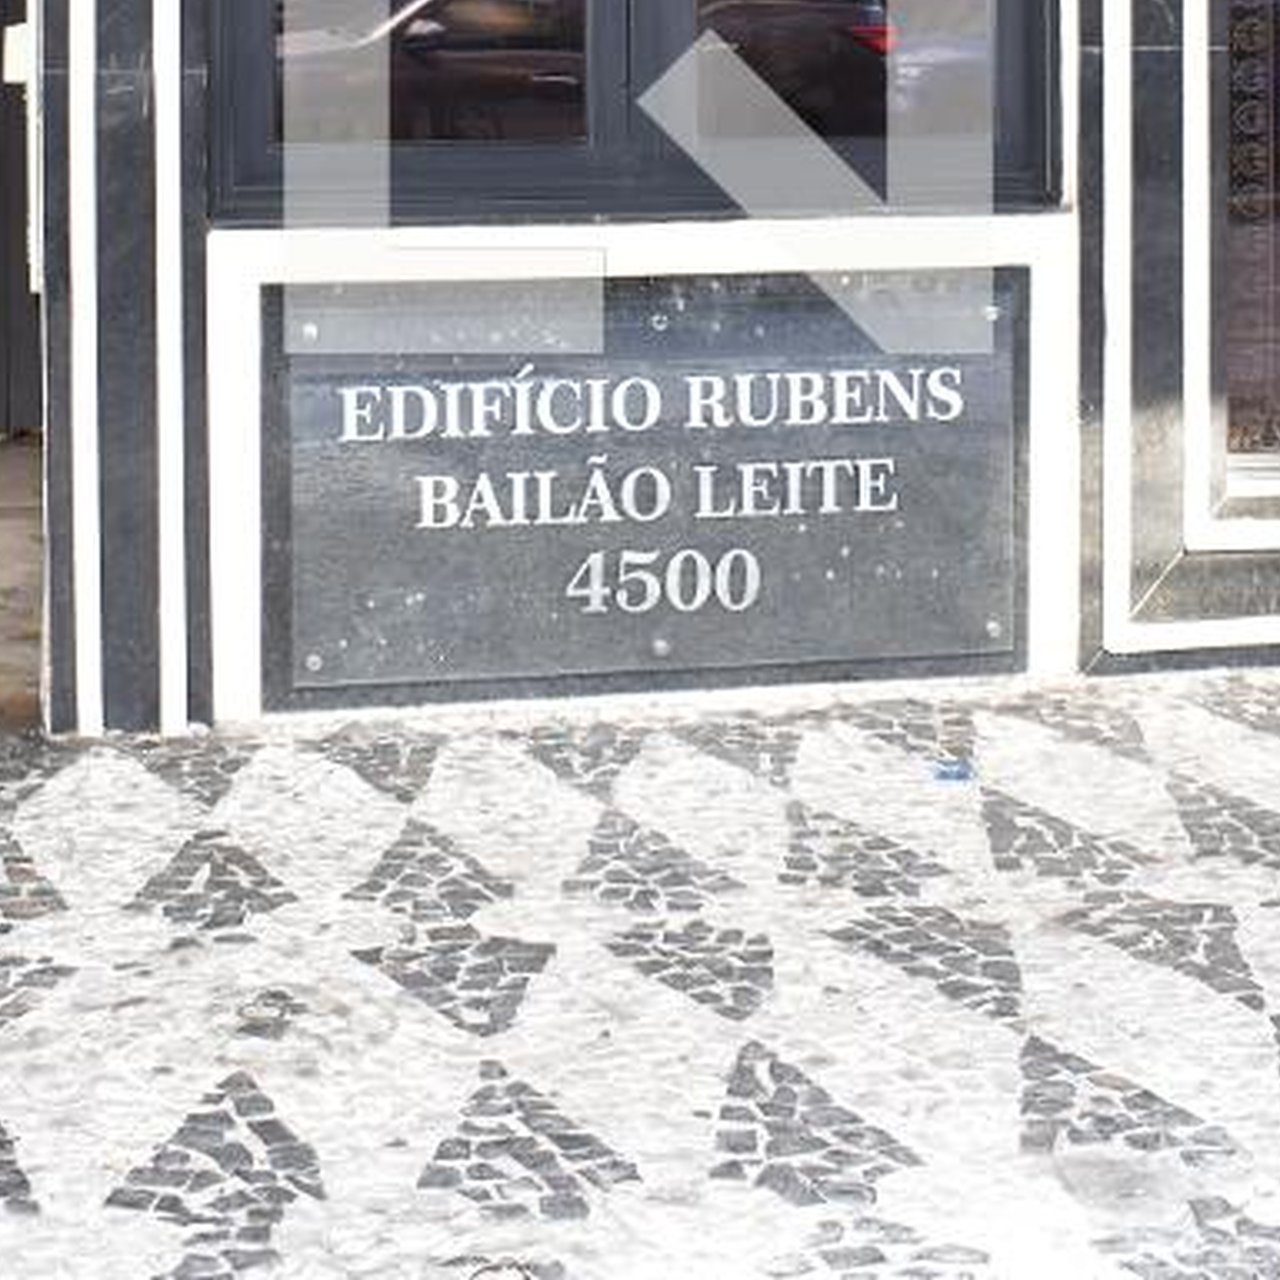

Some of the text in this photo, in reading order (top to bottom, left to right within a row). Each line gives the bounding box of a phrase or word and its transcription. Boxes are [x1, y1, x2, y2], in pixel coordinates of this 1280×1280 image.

[338, 364, 964, 443] EDIFÍCIO RUBENS
[416, 455, 898, 529] BAILÃO LEITE
[565, 549, 761, 613] 4500
